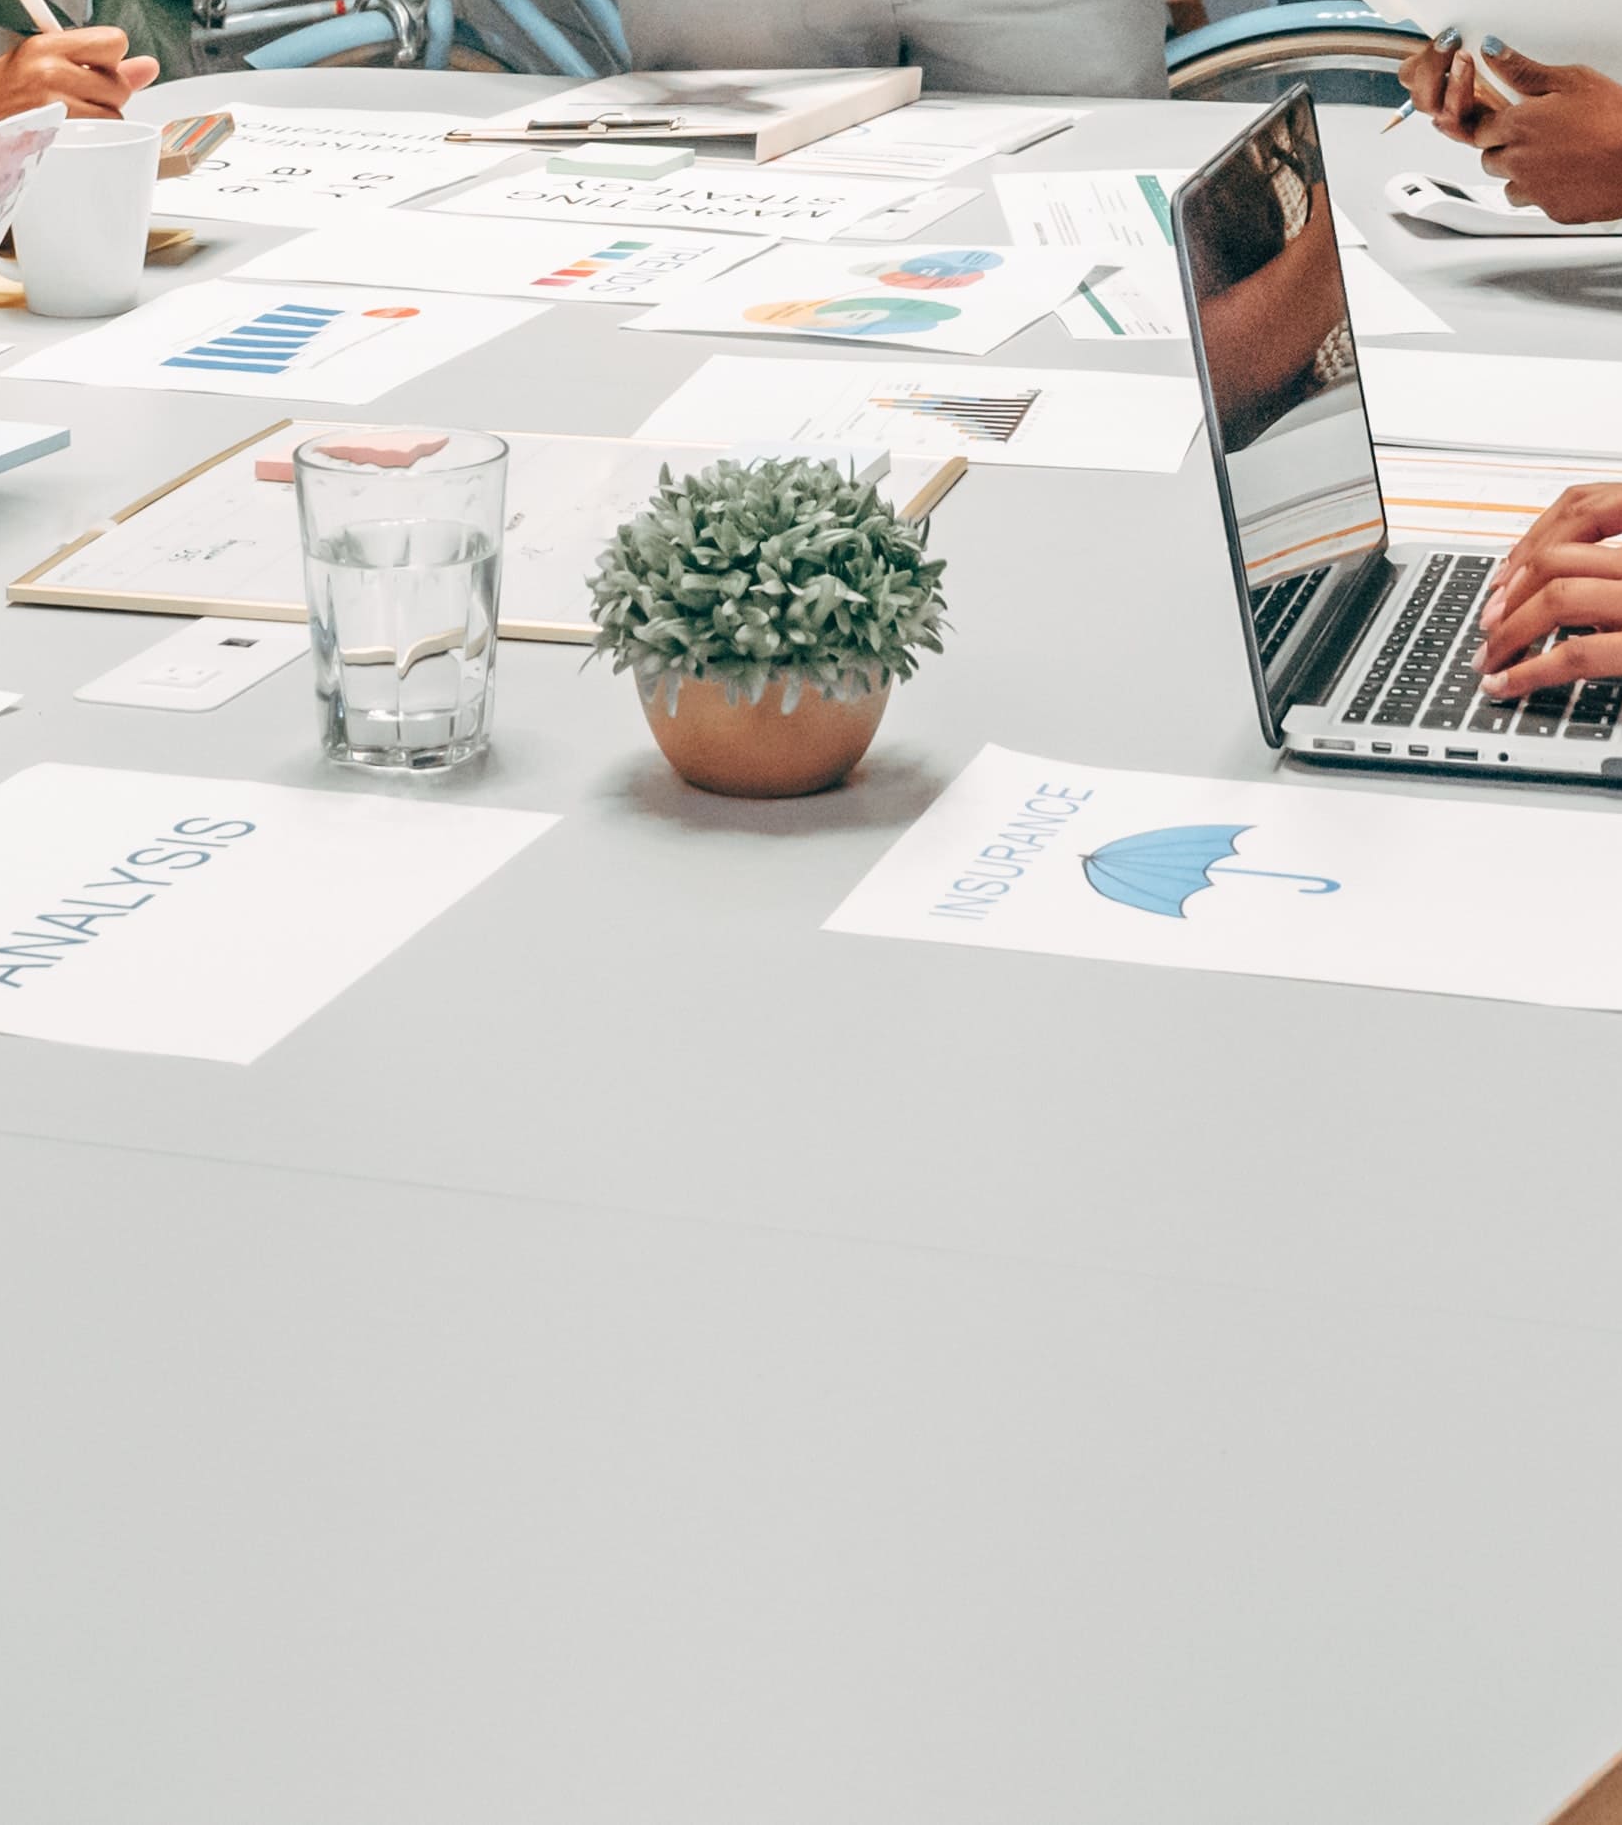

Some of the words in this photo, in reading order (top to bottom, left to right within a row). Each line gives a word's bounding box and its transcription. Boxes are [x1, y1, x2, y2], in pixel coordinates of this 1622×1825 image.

[506, 190, 833, 219] MARKETING
[551, 180, 847, 205] STRATEGY
[588, 245, 716, 294] TRENDS
[928, 781, 1095, 922] INSURANCE
